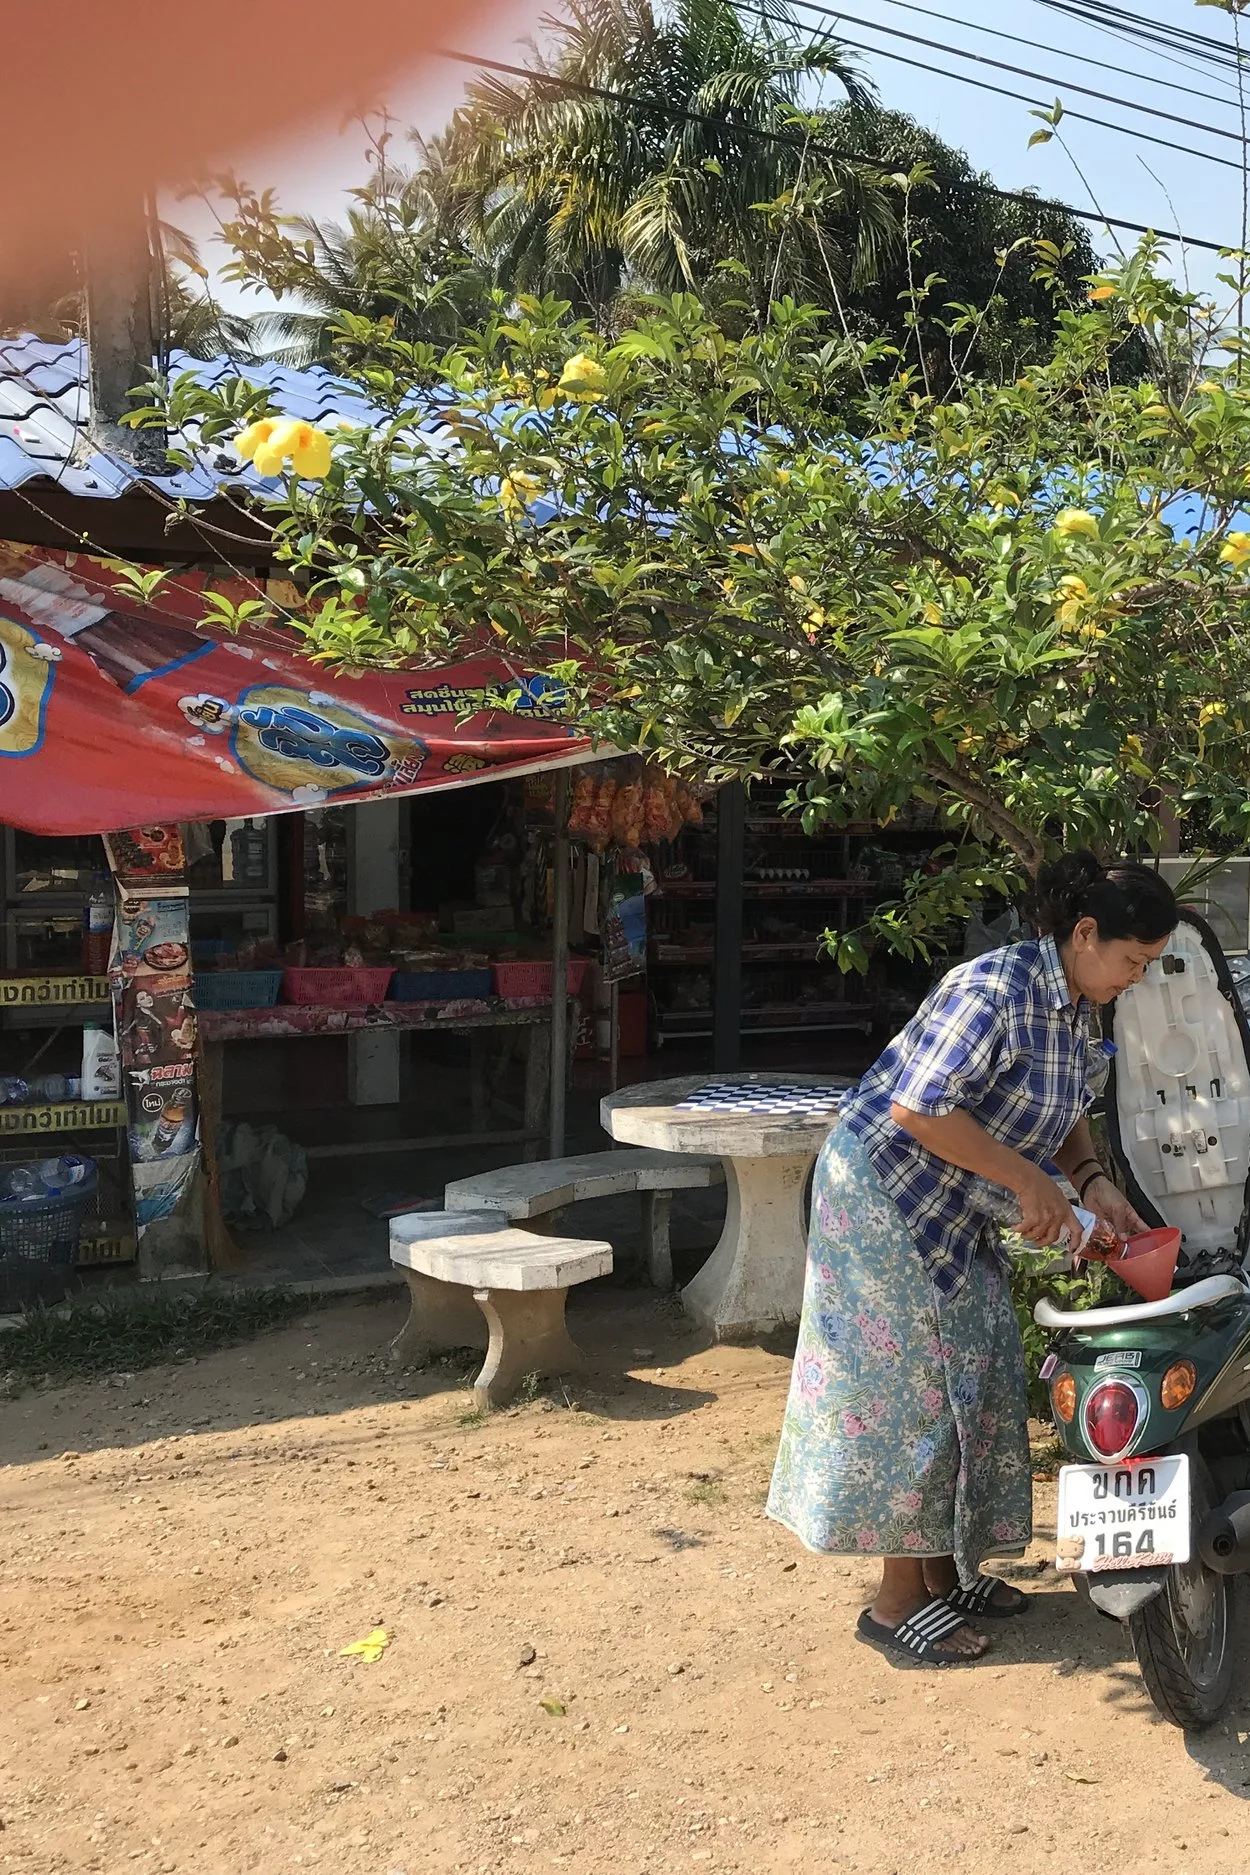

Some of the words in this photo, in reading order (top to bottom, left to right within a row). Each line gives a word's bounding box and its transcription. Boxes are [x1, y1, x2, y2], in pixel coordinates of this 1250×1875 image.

[0, 978, 110, 1002] งกว่าทำไม
[1070, 1499, 1177, 1527] ประจวบคีรีขันธ์
[1095, 1529, 1155, 1557] 164
[1092, 1554, 1135, 1572] Hello
[1134, 1552, 1173, 1568] Kitty
